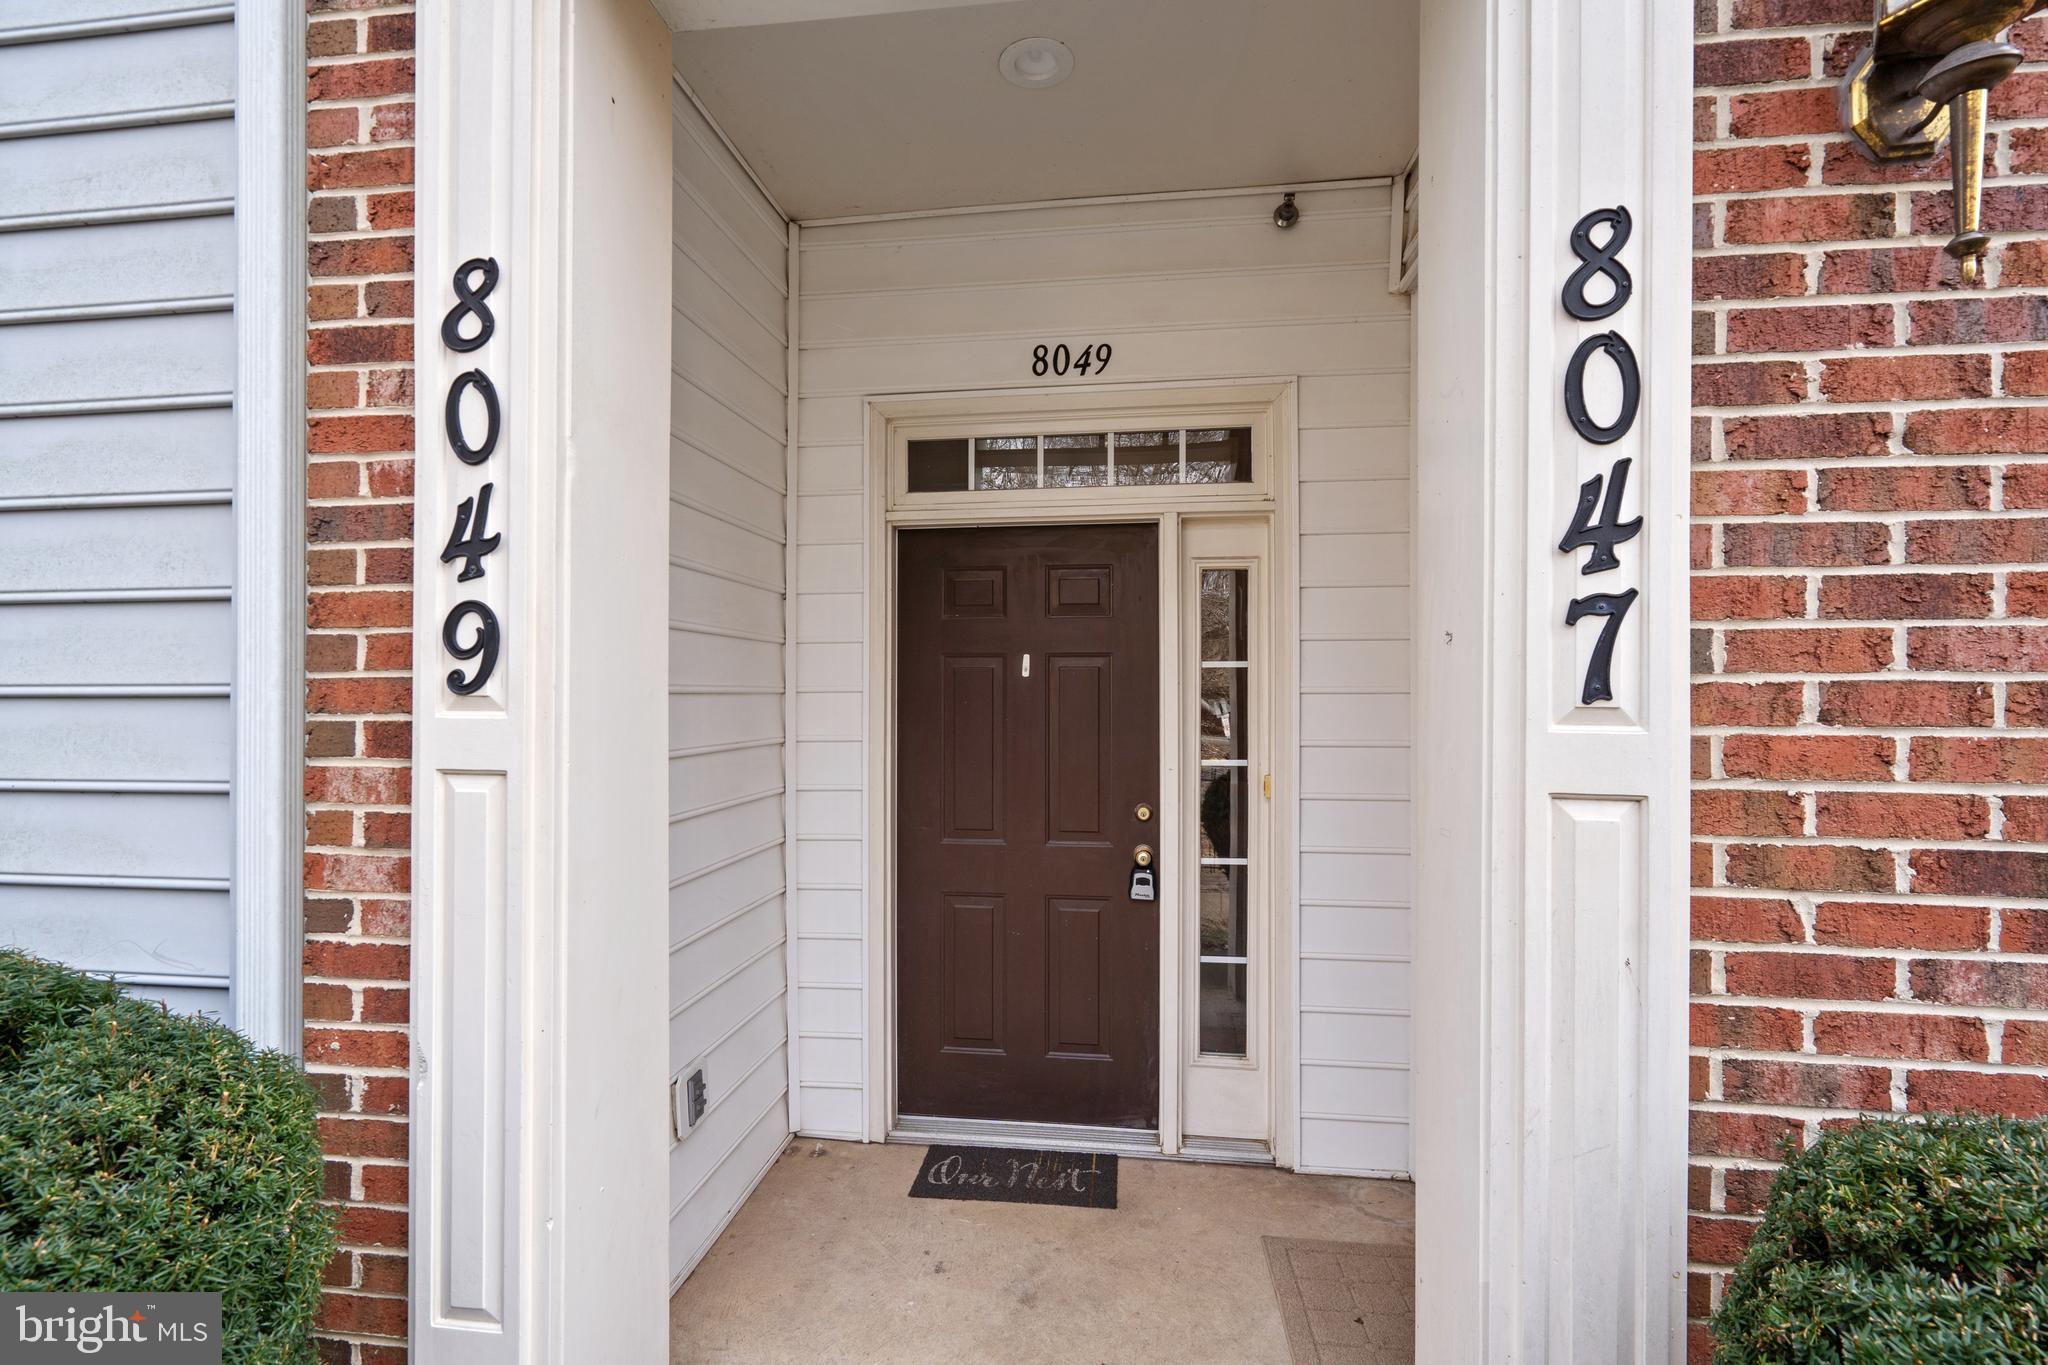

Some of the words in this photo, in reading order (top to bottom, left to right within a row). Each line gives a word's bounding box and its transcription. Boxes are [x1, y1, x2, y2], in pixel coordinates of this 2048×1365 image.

[441, 257, 501, 696] 8049
[1031, 343, 1113, 377] 8049
[1558, 205, 1644, 706] 8047
[927, 1155, 999, 1188] Our
[1006, 1158, 1101, 1192] Nest
